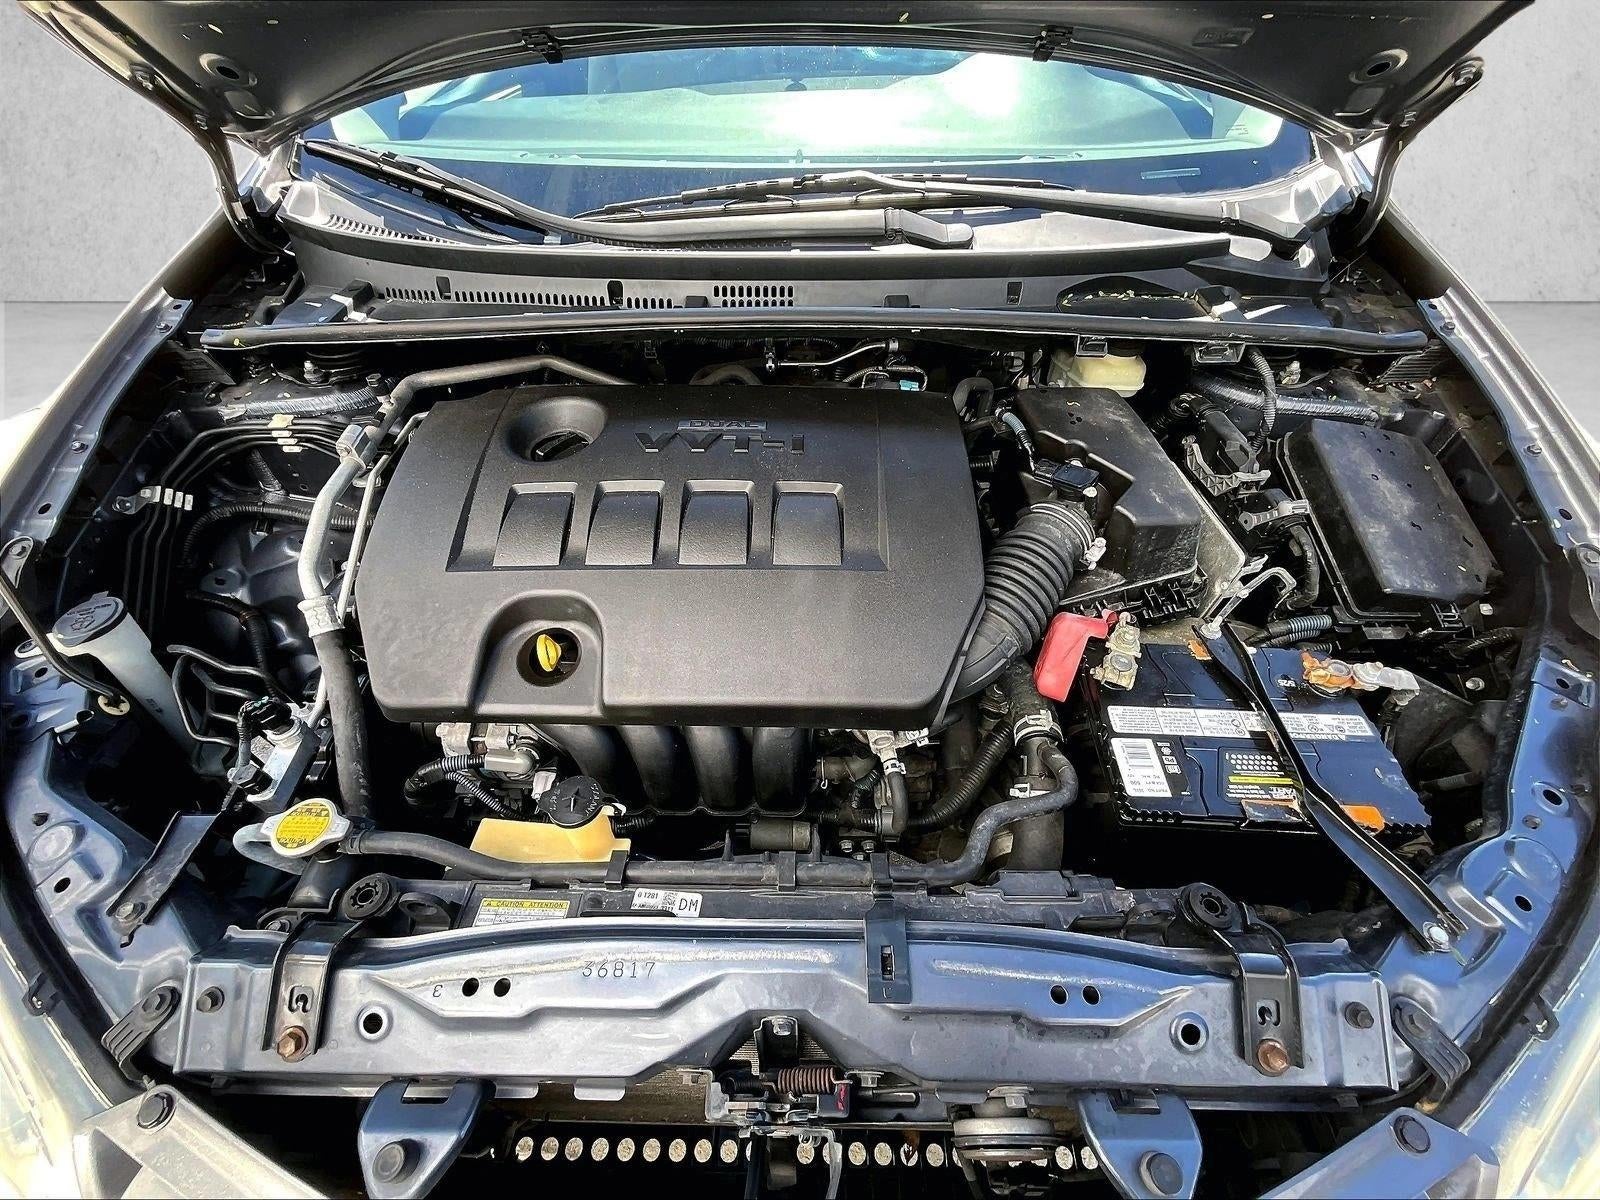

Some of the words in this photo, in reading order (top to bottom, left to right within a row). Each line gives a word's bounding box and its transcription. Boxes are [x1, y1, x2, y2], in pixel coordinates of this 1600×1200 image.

[689, 419, 760, 429] DUAL
[678, 897, 699, 912] DM
[582, 960, 656, 978] 36817
